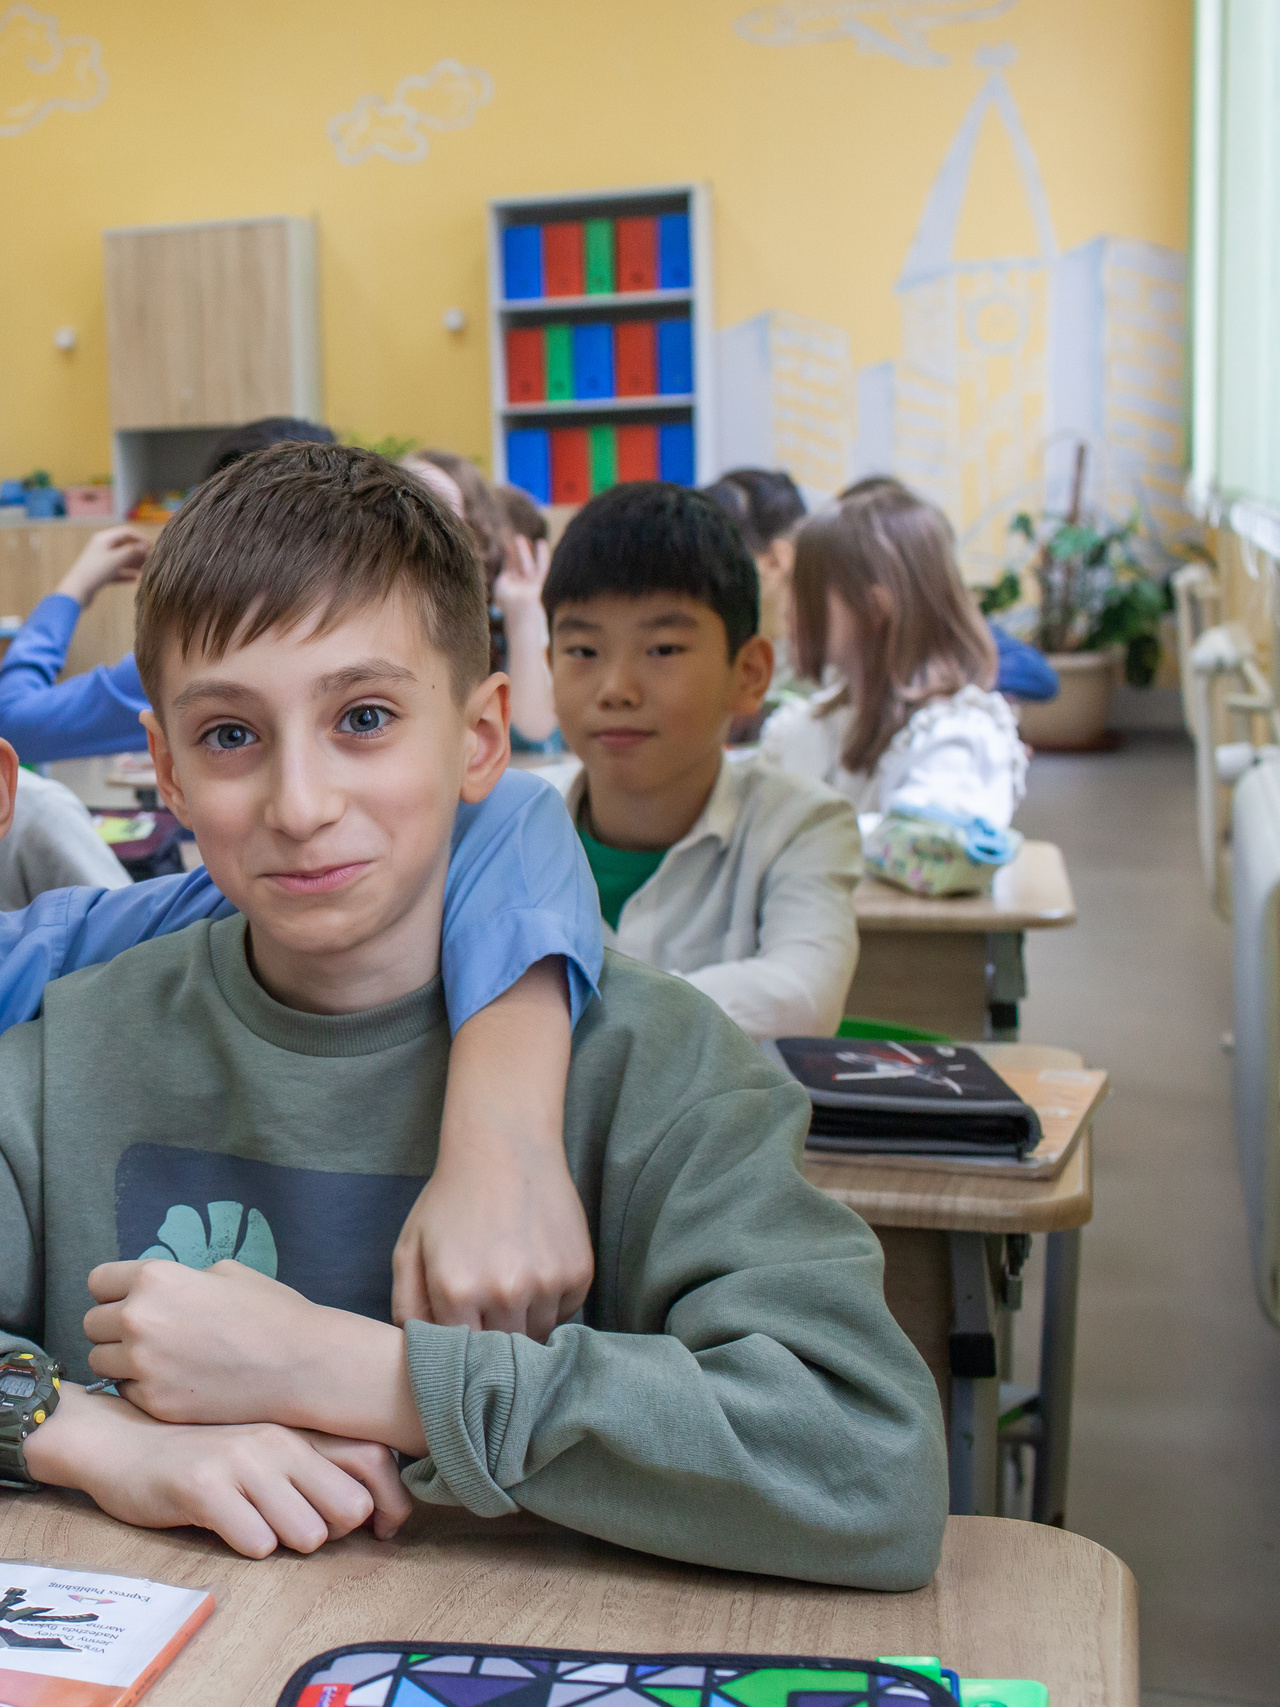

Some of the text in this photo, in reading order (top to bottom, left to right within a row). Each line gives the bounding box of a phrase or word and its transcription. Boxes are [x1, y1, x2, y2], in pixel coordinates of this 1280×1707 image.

[48, 1582, 152, 1603] Express Publishing
[61, 1626, 119, 1640] Nadezhda
[85, 1623, 126, 1633] Marina
[77, 1637, 113, 1646] Jenny
